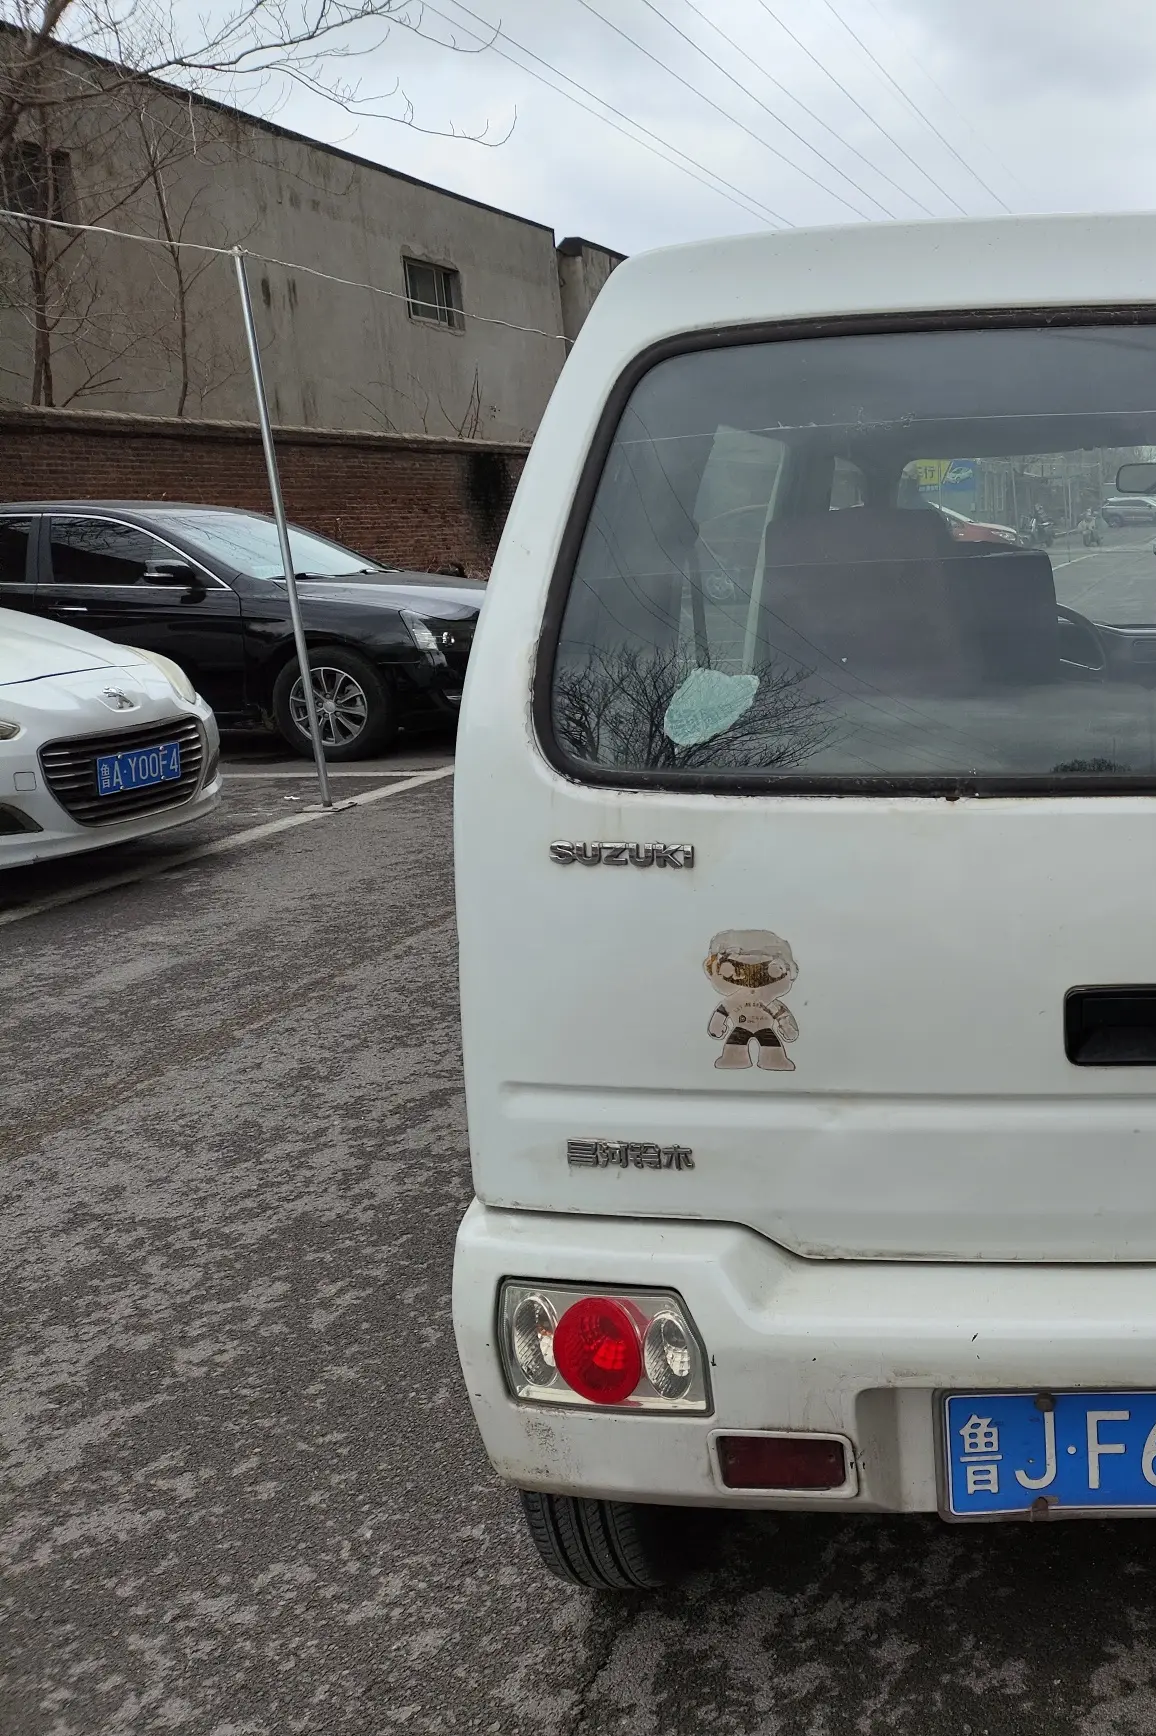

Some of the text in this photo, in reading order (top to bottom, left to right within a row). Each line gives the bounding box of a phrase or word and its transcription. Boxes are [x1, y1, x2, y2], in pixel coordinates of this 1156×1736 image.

[549, 840, 695, 869] SUZUKI
[567, 1138, 695, 1171] 昌河铃木
